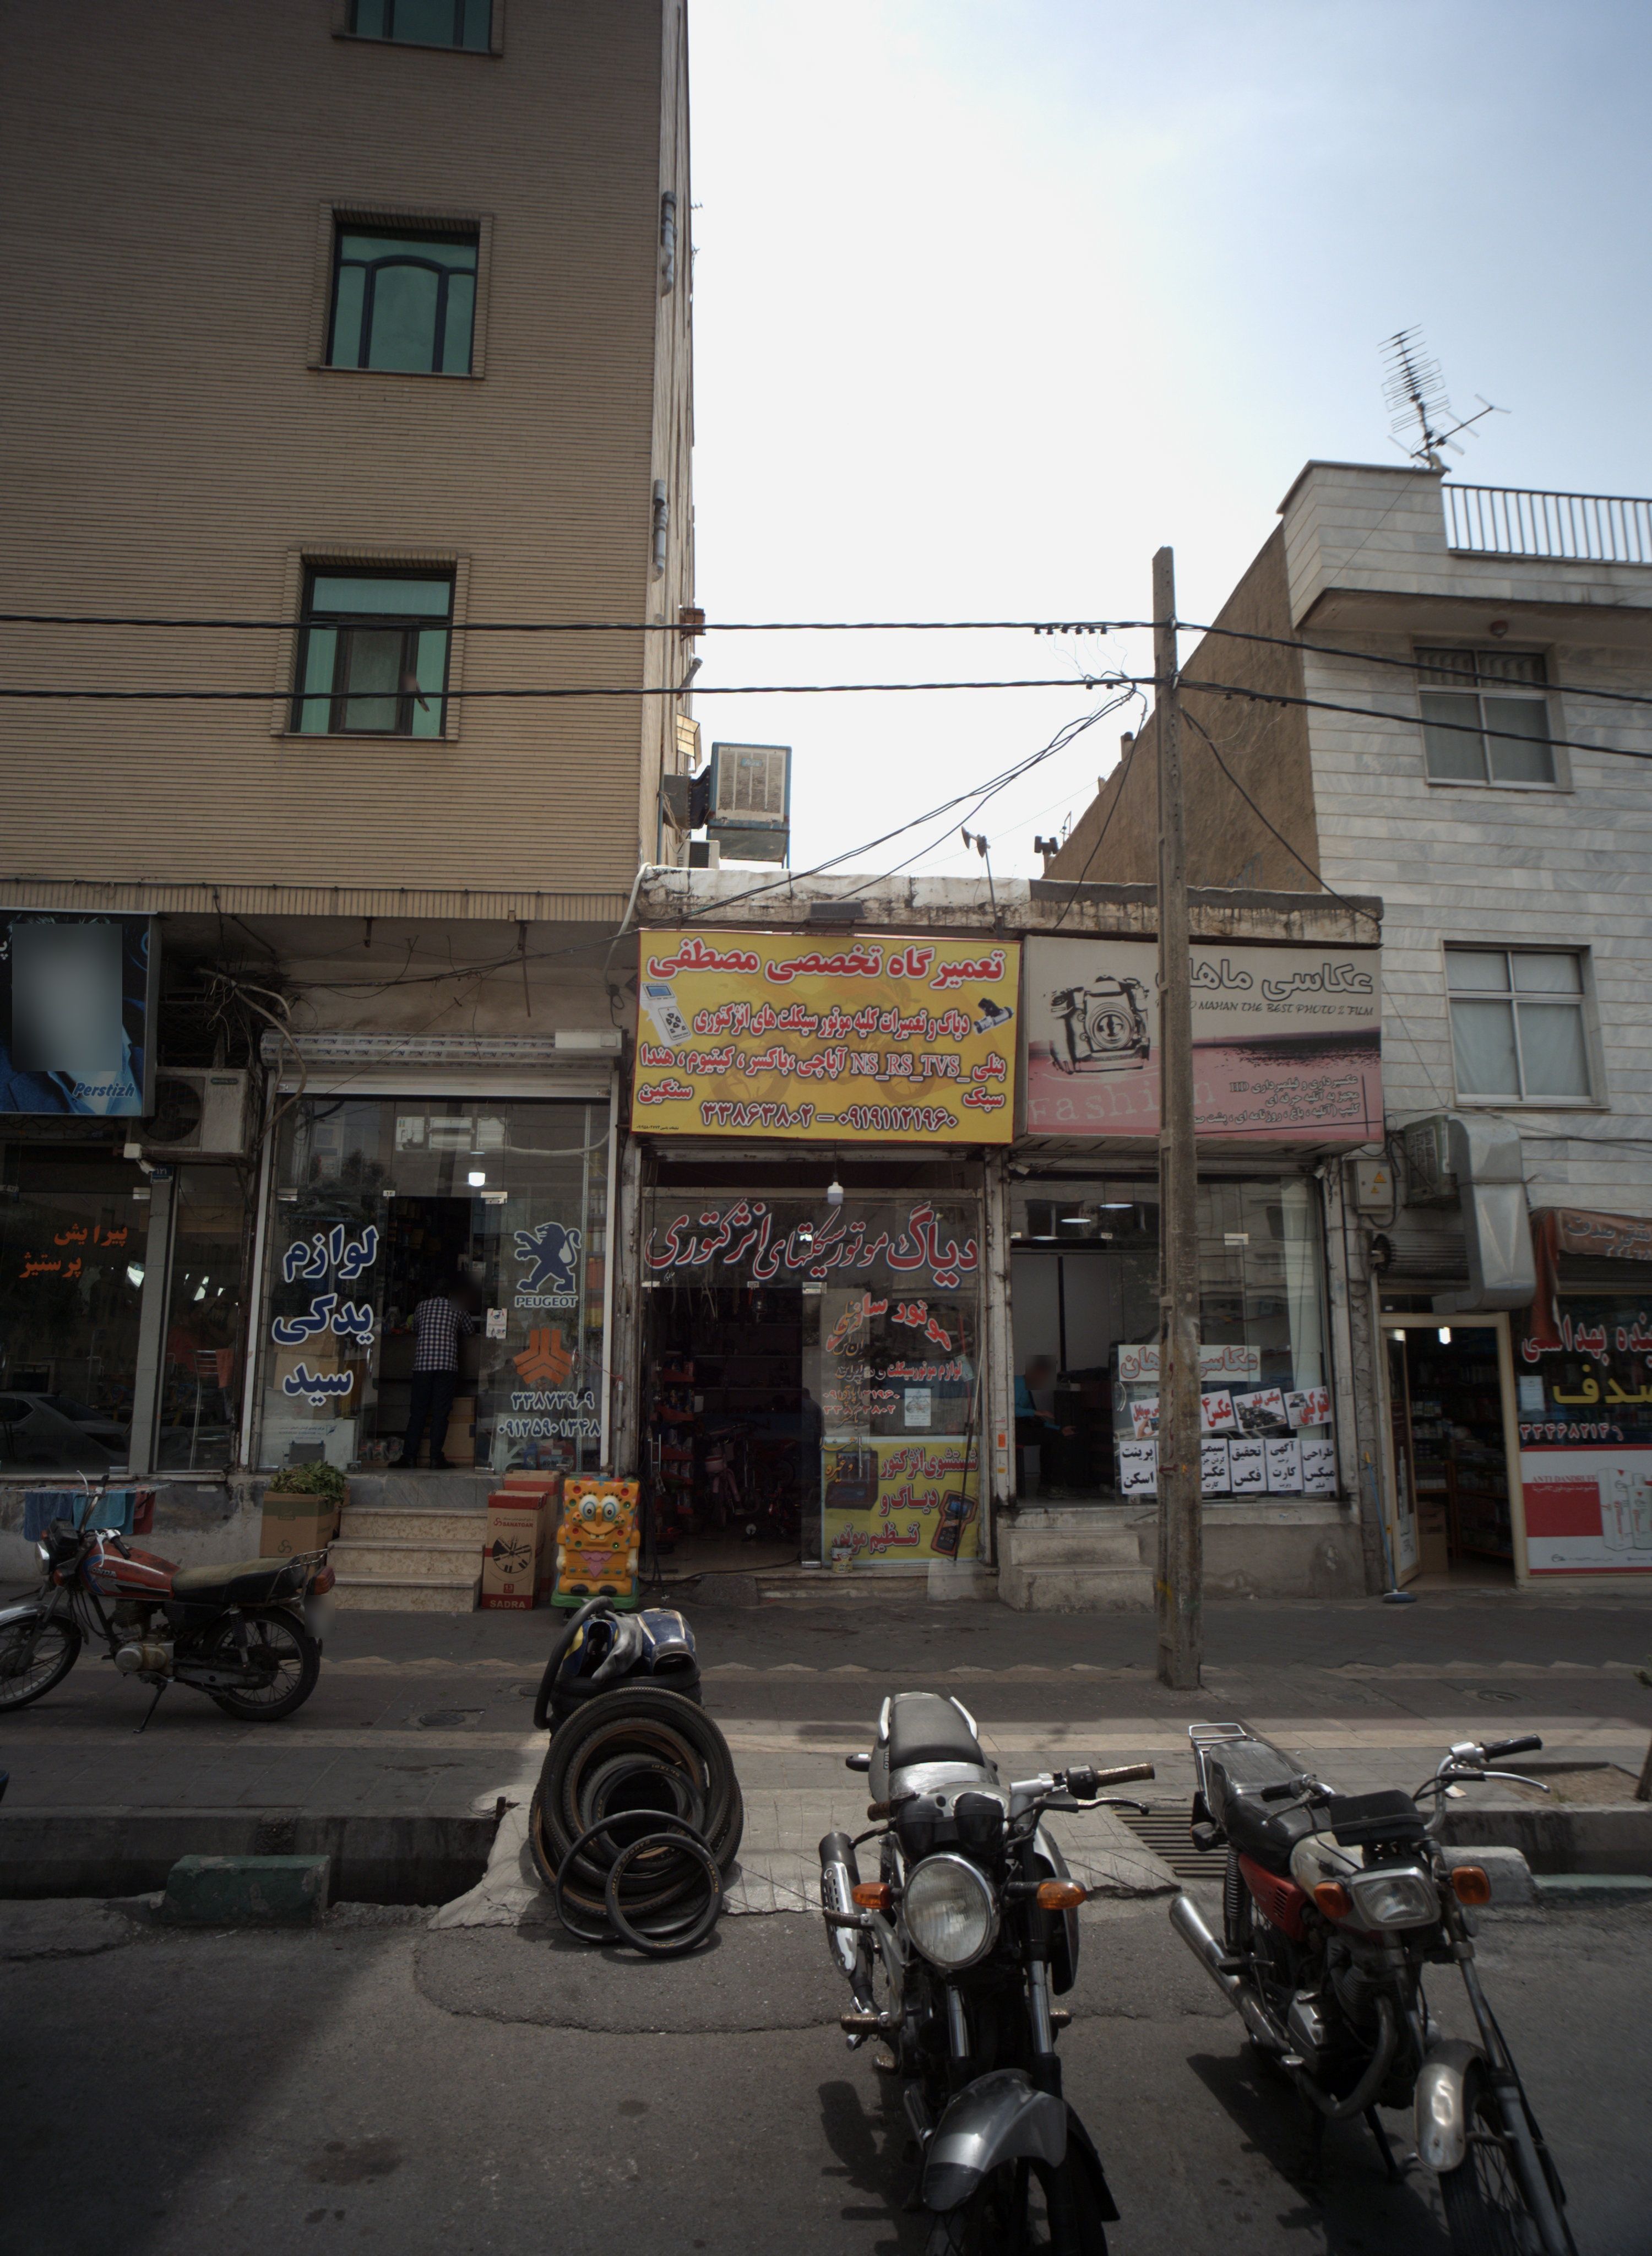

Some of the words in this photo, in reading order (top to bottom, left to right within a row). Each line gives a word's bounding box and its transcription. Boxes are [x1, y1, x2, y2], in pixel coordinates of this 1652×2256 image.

[648, 937, 760, 980] مصطفی
[765, 943, 883, 984] تخصصی
[1262, 963, 1373, 1001] عکاسی
[694, 1002, 750, 1035] انژکتوری
[1199, 1001, 1238, 1011] MAHAN
[1242, 1002, 1263, 1012] THE
[1267, 1004, 1294, 1013] BEST
[1296, 1004, 1336, 1014] PHOTO
[854, 1006, 879, 1038] کلیه
[880, 1007, 927, 1040] تعمیرات
[926, 1018, 937, 1041] و
[937, 1010, 970, 1040] دیاگ
[640, 1043, 675, 1067] هندا
[798, 1046, 849, 1078] آپاچی
[973, 1053, 1007, 1082] بنلی
[73, 1082, 135, 1098] Perstizh
[638, 1080, 693, 1103] سنگین
[964, 1087, 1005, 1112] سبک
[1230, 1081, 1249, 1092] HD
[1029, 1080, 1216, 1124] Fashin
[702, 1102, 814, 1127] ۳۳۸۶۳۸۰۲
[838, 1105, 958, 1131] ۰۹۱۹۱۱۲۱۹۶۰
[54, 1222, 128, 1247] پیرایش
[644, 1198, 772, 1270] انژکتوری
[887, 1201, 978, 1288] دیاگ
[283, 1224, 379, 1283] لوازم
[515, 1296, 578, 1308] PEUGEOT
[271, 1293, 374, 1345] یدکی
[938, 1360, 963, 1381] لوازم
[1121, 1346, 1160, 1379] هان
[283, 1362, 354, 1406] سید
[1208, 1399, 1231, 1427] عکس
[497, 1418, 601, 1438] ۰۹۱۲۵۹۰۱۳۴۸
[1123, 1447, 1153, 1461] پرینت
[1232, 1446, 1261, 1461] تحقیق
[1270, 1441, 1294, 1456] آگهی
[1304, 1448, 1333, 1461] طراحی
[879, 1447, 925, 1479] انژکتور
[1273, 1467, 1296, 1480] کارت
[1305, 1467, 1335, 1482] میکس
[1124, 1472, 1154, 1488] اسکن
[879, 1493, 889, 1516] و
[890, 1484, 939, 1514] دیاگ
[870, 1521, 920, 1554] تنظیم
[490, 1600, 526, 1609] SADRA
